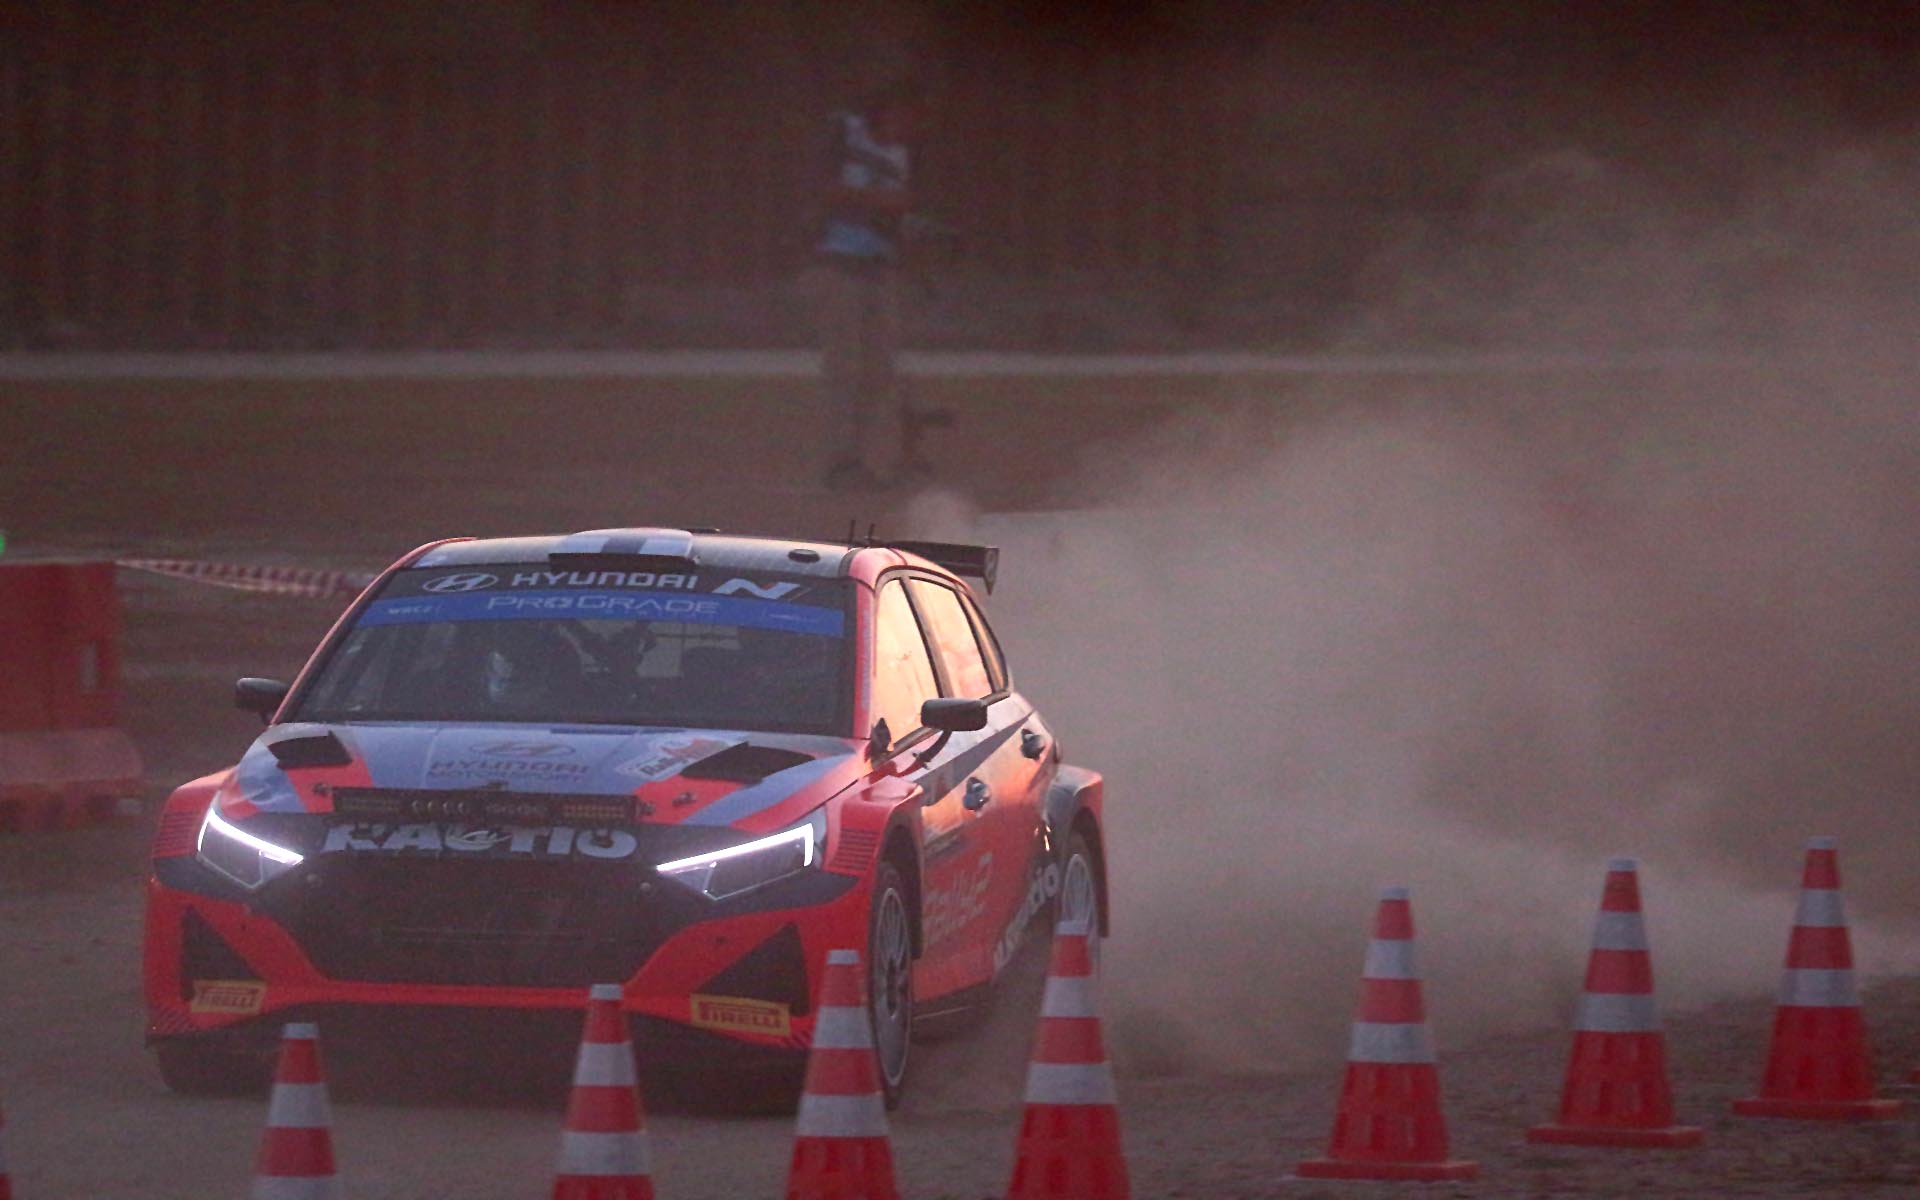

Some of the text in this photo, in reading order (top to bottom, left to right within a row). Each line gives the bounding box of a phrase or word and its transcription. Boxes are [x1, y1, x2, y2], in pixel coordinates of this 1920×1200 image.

[511, 571, 698, 590] HYUNDAI
[430, 759, 591, 774] HYUNDAI
[198, 986, 259, 1010] PIRELLI
[698, 1001, 782, 1030] PIRELLI
